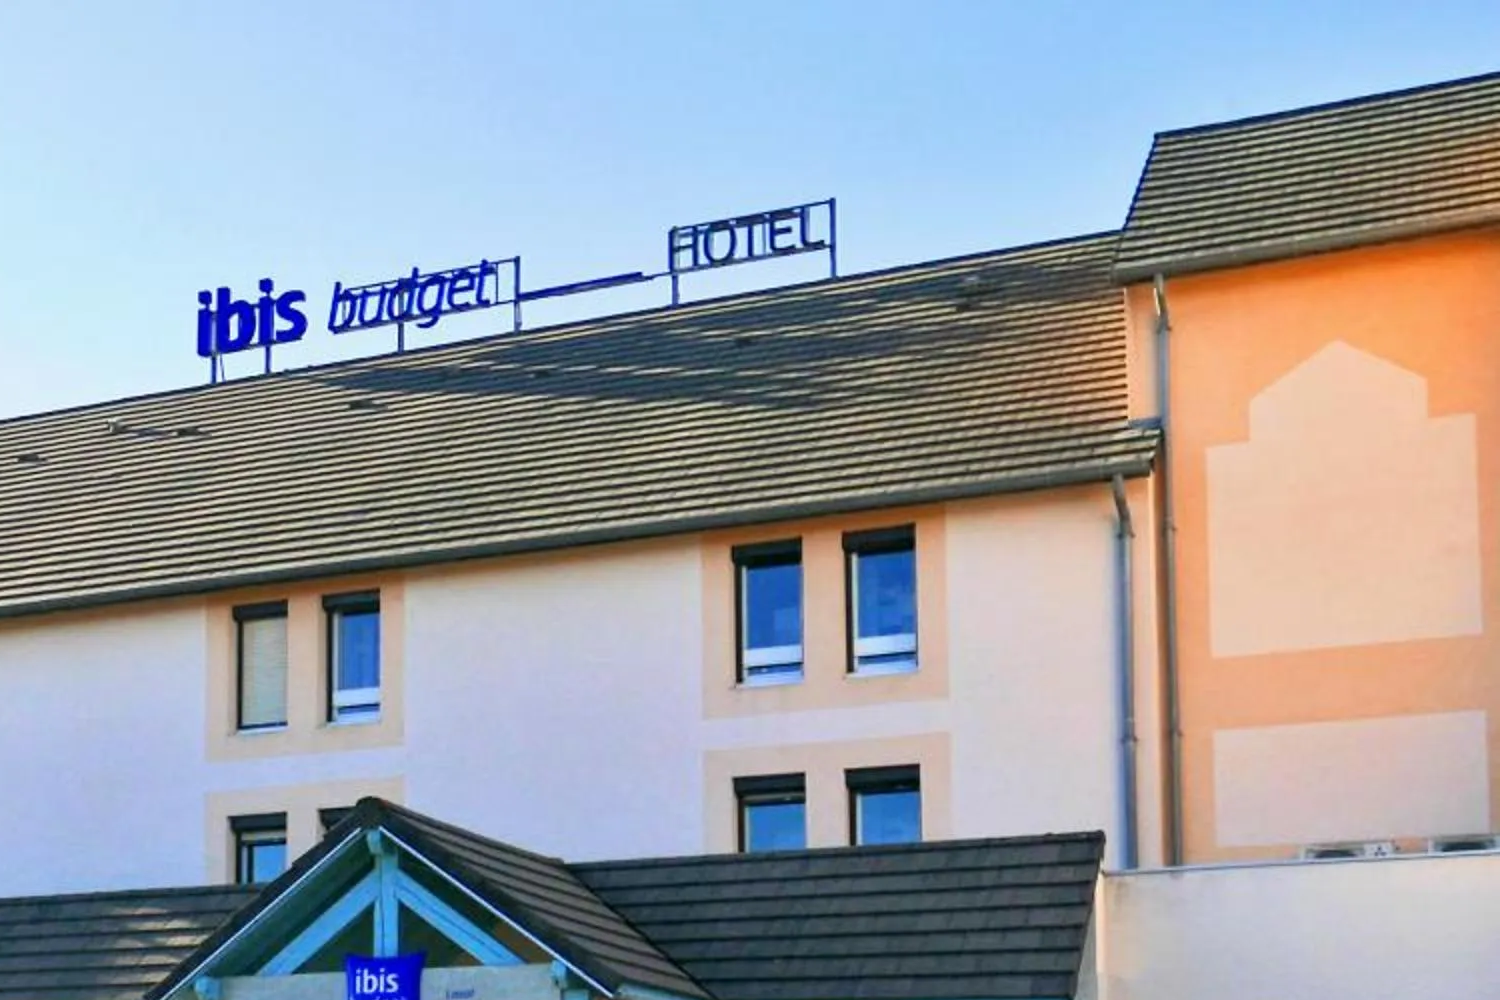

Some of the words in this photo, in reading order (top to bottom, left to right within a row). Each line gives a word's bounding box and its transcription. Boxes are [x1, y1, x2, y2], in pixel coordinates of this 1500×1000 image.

[197, 278, 308, 358] ibis
[328, 259, 495, 335] budget
[668, 206, 826, 274] HOTEL
[355, 967, 400, 994] ibis
